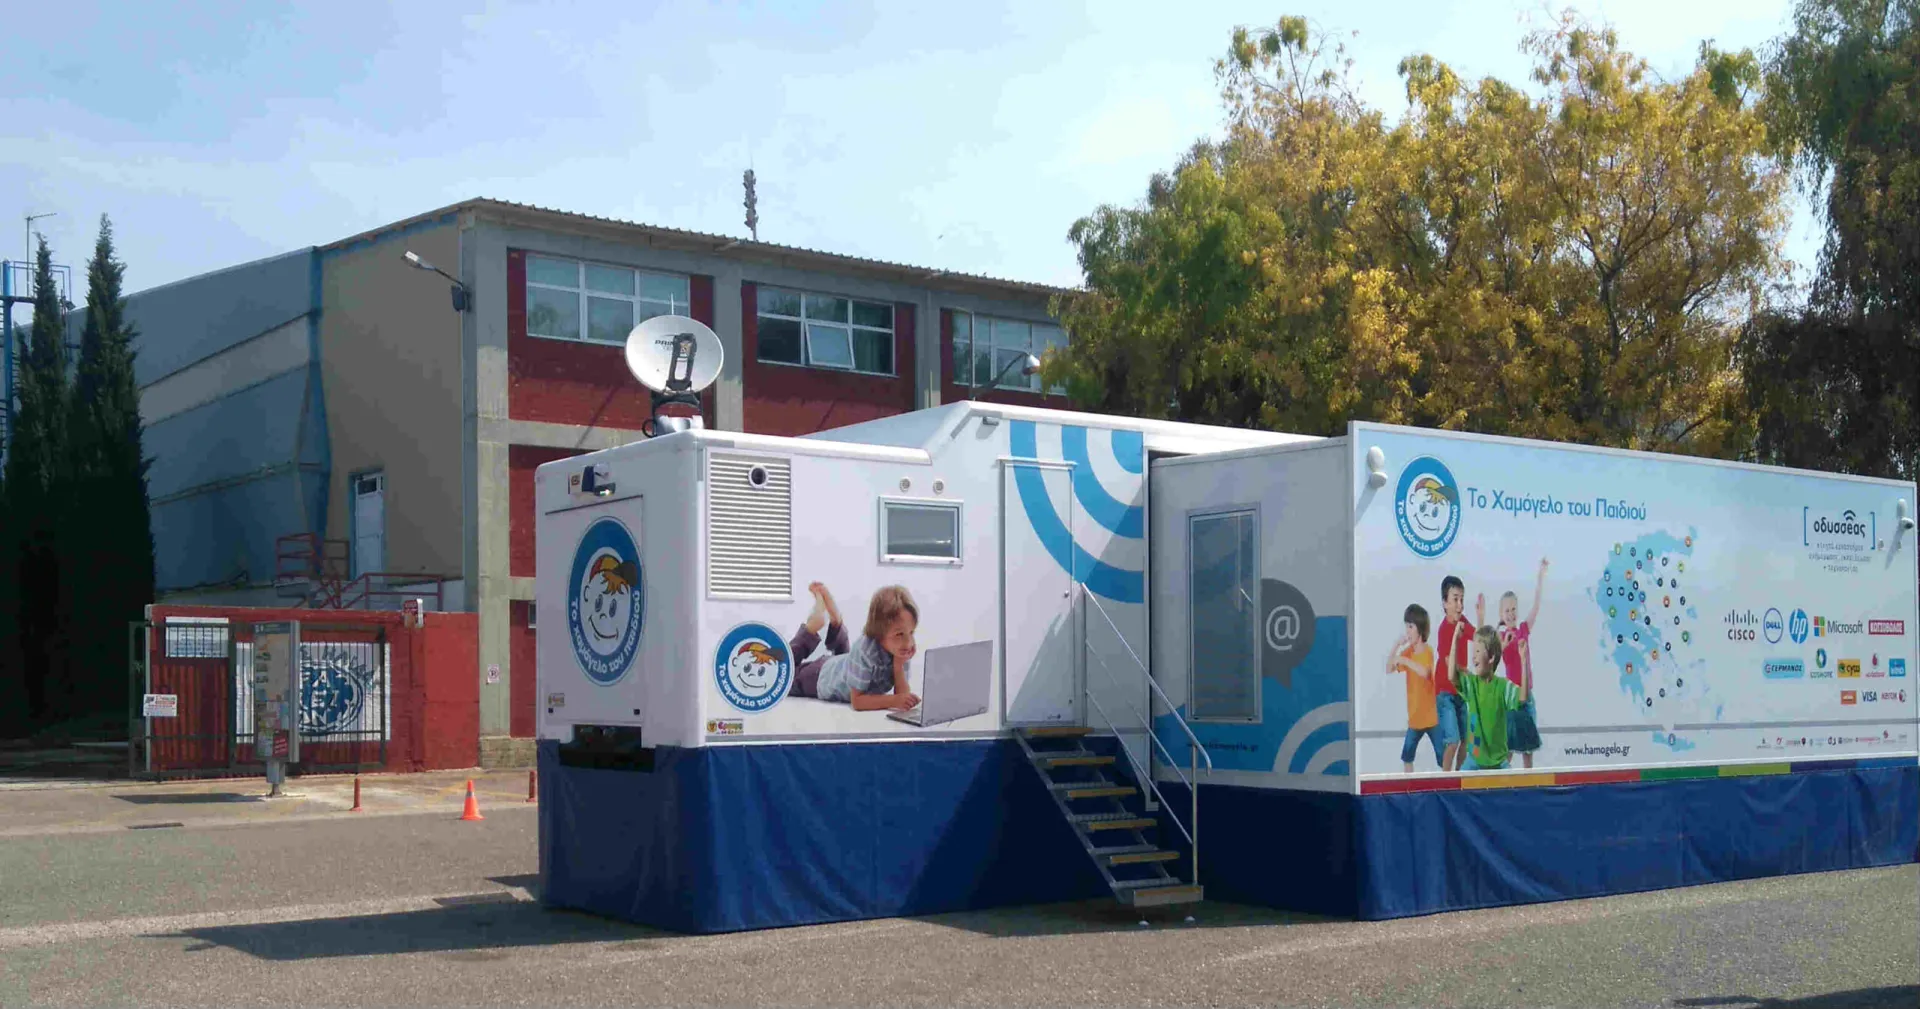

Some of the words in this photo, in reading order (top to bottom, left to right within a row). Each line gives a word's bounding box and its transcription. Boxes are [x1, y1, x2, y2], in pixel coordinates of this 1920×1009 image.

[1467, 487, 1487, 509] Το
[1491, 489, 1563, 518] Χαμόγελο
[1567, 501, 1591, 516] του
[1596, 498, 1646, 520] Παιδιού
[571, 598, 579, 621] Το
[624, 589, 641, 657] παιδιού
[1265, 605, 1300, 651] @
[1790, 609, 1807, 644] hp
[1827, 620, 1863, 634] Microsoft
[1728, 629, 1755, 641] CISCO
[571, 625, 608, 674] χαμόγελο
[610, 656, 625, 673] του
[718, 663, 727, 676] Το
[1772, 665, 1802, 673] ΓΕΡΜΑΝΟΣ
[771, 663, 787, 698] παιδιού
[721, 678, 756, 707] χαμόγελο
[757, 696, 772, 707] του
[1861, 691, 1878, 702] VISA
[1564, 742, 1631, 757] www.hamogelo.gr
